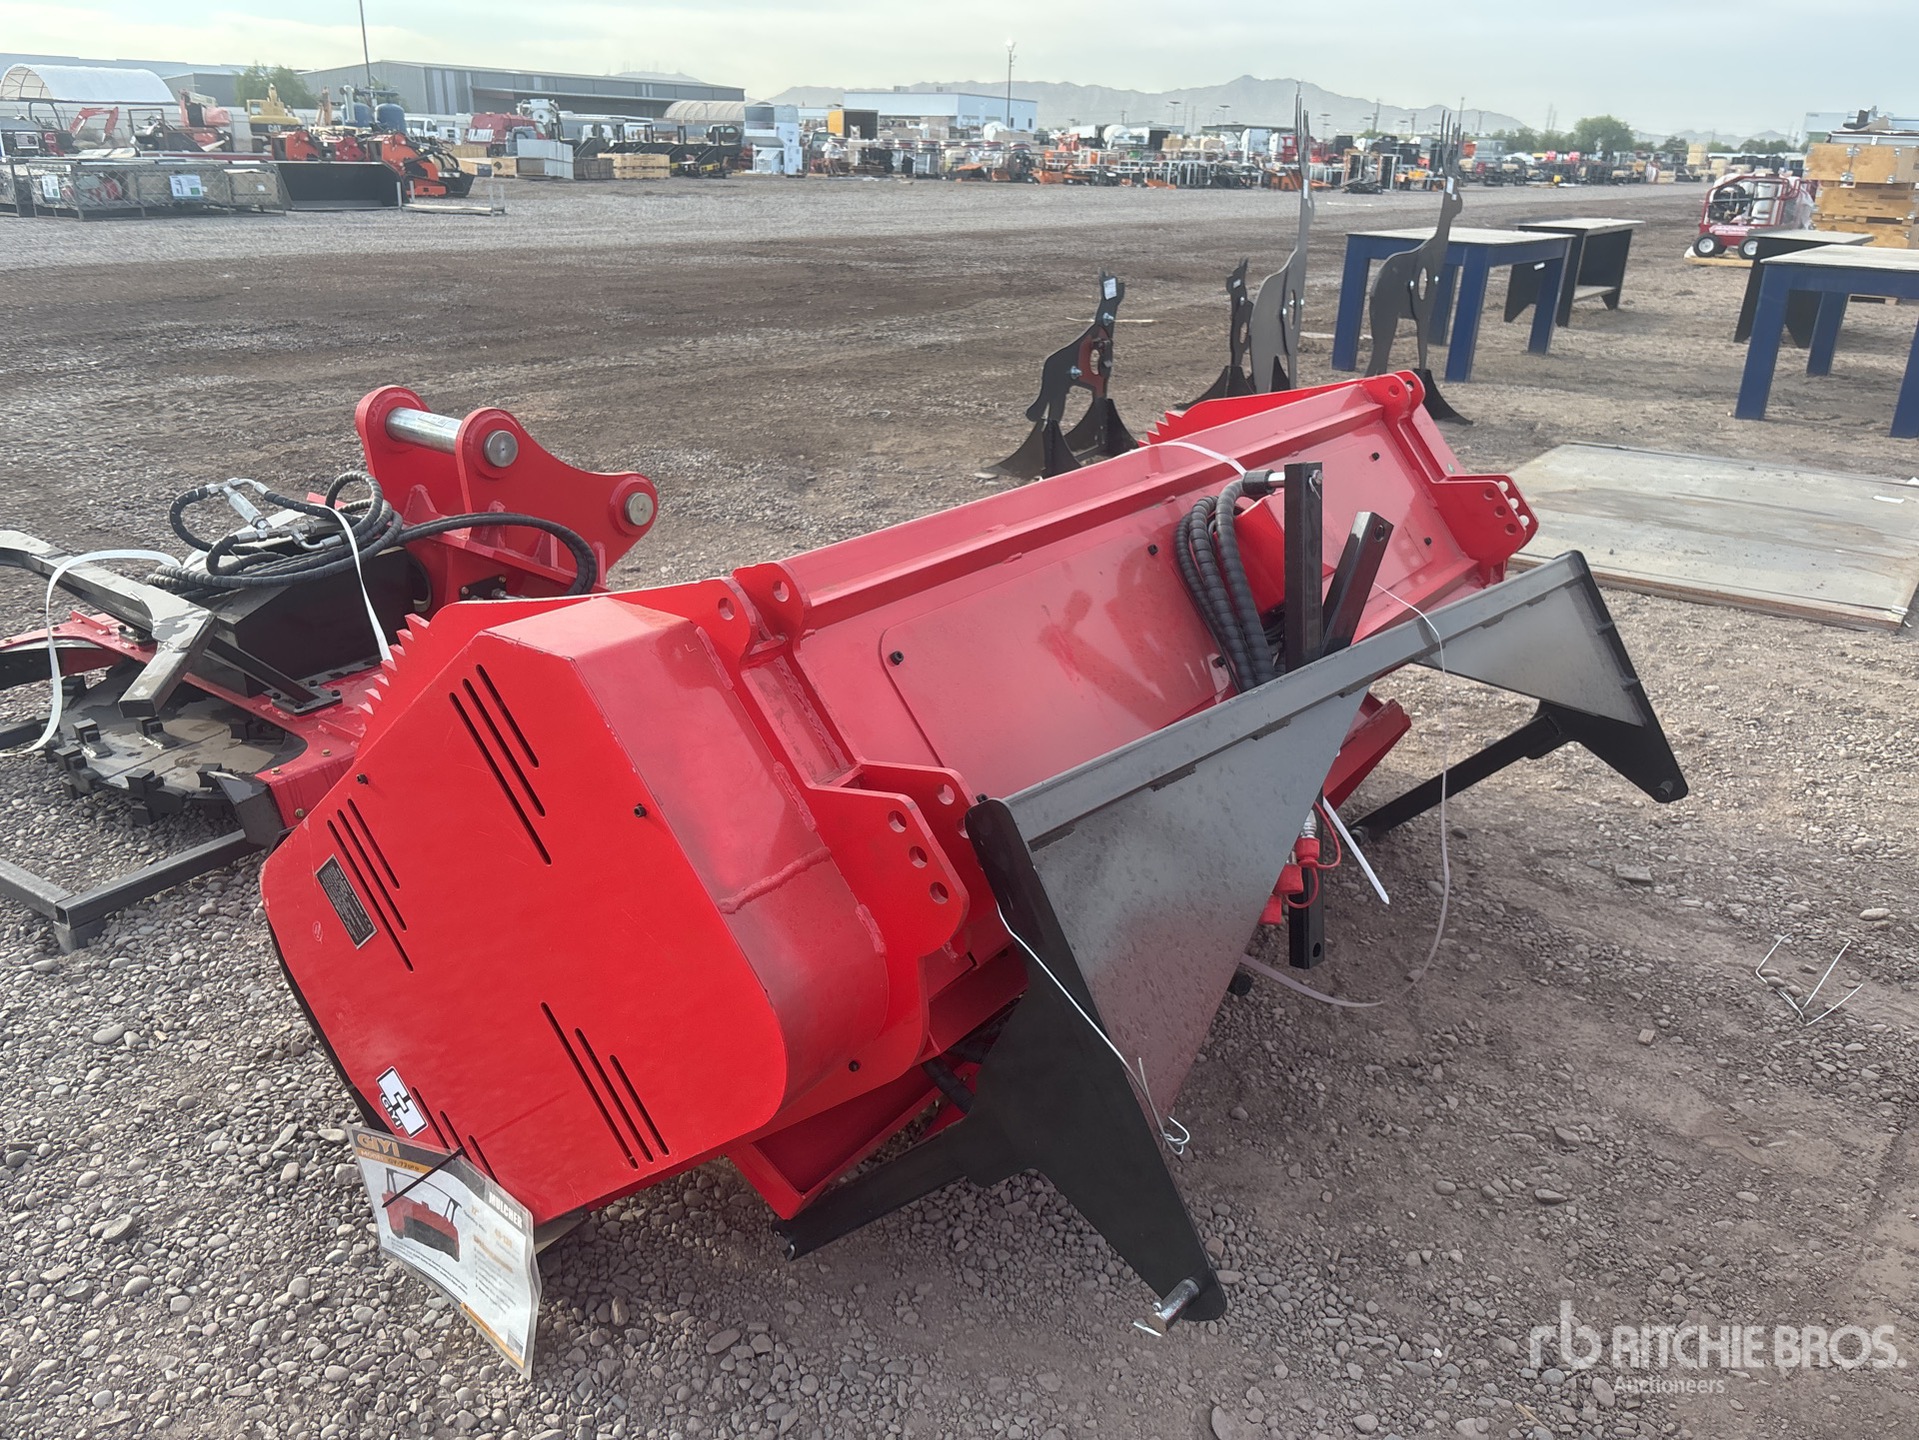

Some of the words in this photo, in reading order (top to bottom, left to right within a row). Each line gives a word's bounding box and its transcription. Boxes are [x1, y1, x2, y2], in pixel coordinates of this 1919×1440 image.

[381, 1095, 402, 1126] GIYI
[357, 1133, 400, 1158] GIYI
[489, 1191, 523, 1229] MULCHER
